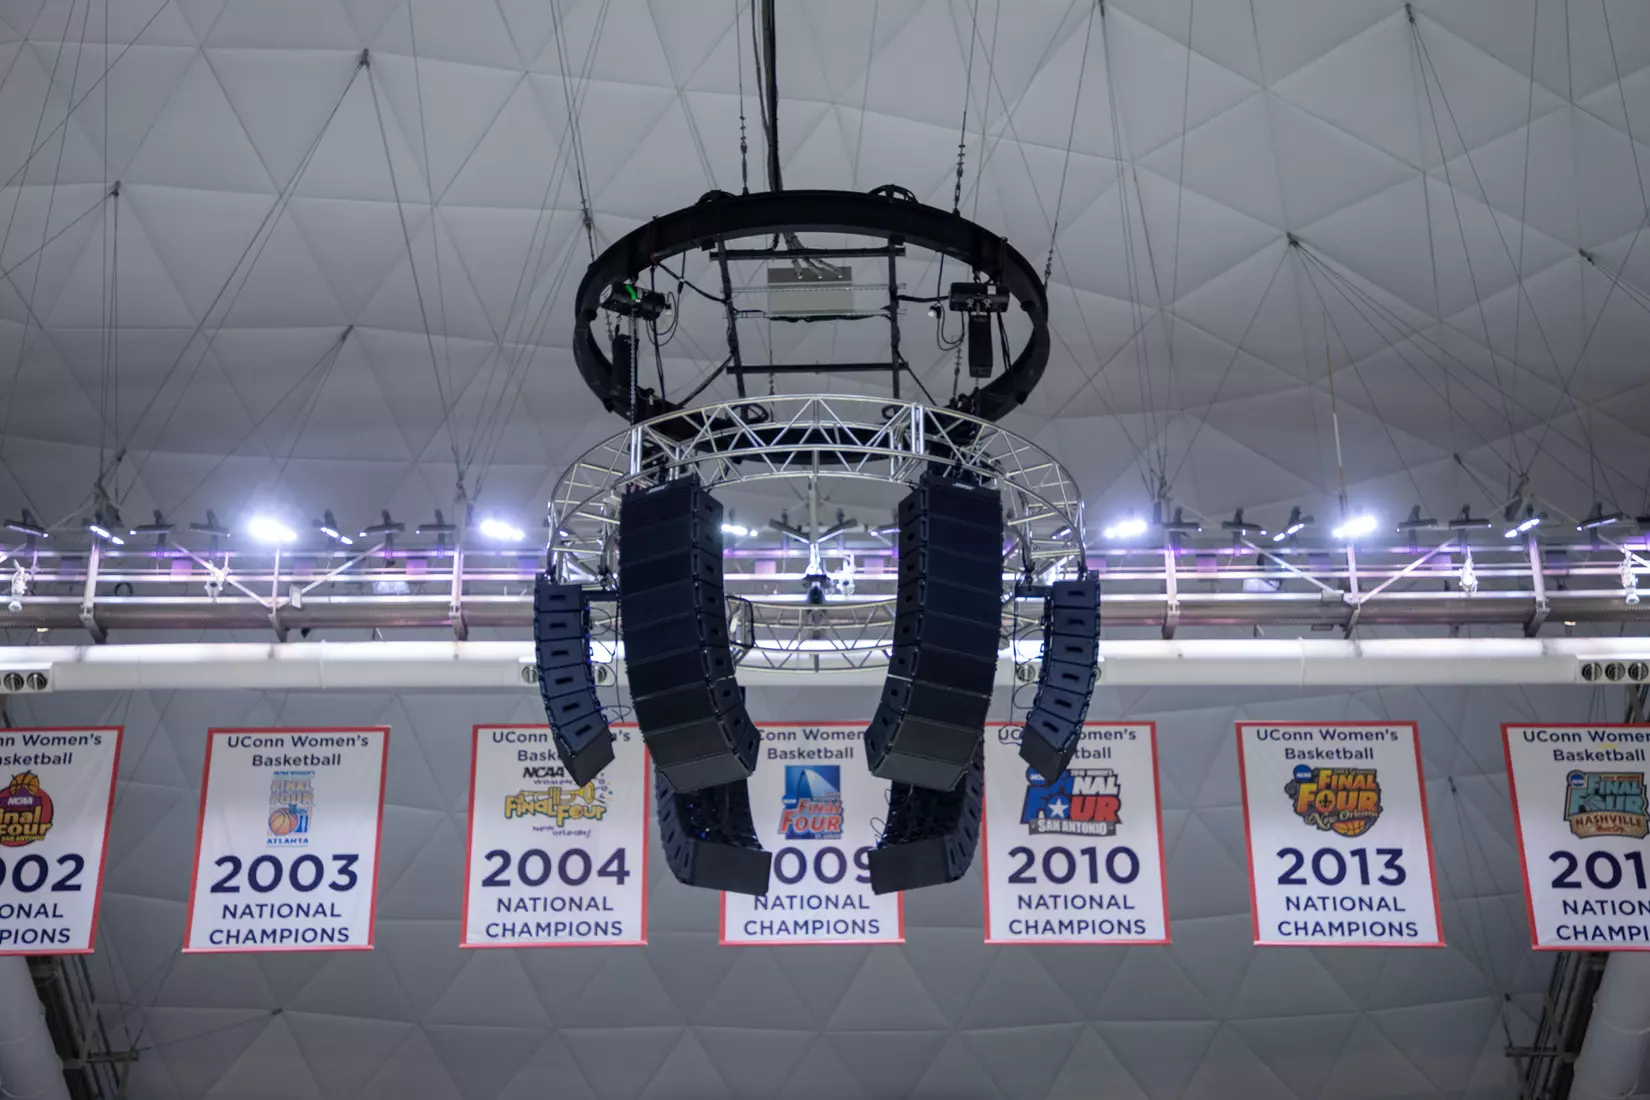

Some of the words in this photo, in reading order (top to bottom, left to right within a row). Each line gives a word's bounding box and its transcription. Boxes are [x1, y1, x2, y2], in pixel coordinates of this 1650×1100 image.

[22, 733, 102, 746] Women's
[227, 736, 284, 748] UConn
[291, 734, 369, 748] Women's
[492, 731, 548, 743] UConn
[1080, 728, 1137, 741] omen's
[1256, 729, 1313, 741] UConn
[1319, 728, 1398, 741] Women's
[1523, 730, 1582, 743] UConn
[0, 752, 72, 766] sketball
[252, 753, 341, 767] Basketball
[767, 747, 854, 760] Basketball
[1285, 747, 1374, 760] Basketball
[1553, 749, 1645, 762] Basketball
[522, 766, 565, 779] NCAA
[1319, 769, 1377, 789] FINAL
[1297, 783, 1378, 813] FOUR
[1038, 819, 1060, 832] SAN
[1062, 820, 1107, 835] ANTONIO
[1575, 815, 1643, 828] NASHVILLE
[0, 853, 85, 893] 02
[210, 853, 359, 893] 2003
[481, 847, 630, 887] 2004
[1008, 846, 1140, 885] 2010
[1276, 847, 1407, 886] 2013
[496, 896, 614, 913] NATIONAL
[754, 894, 870, 910] NATIONAL
[1018, 894, 1135, 910] NATIONAL
[1285, 896, 1406, 912] NATIONAL
[221, 903, 342, 919] NATIONAL
[485, 921, 623, 938] CHAMPIONS
[744, 919, 880, 936] CHAMPIONS
[1009, 919, 1146, 936] CHAMPIONS
[1277, 921, 1418, 938] CHAMPIONS
[209, 927, 350, 945] CHAMPIONS
